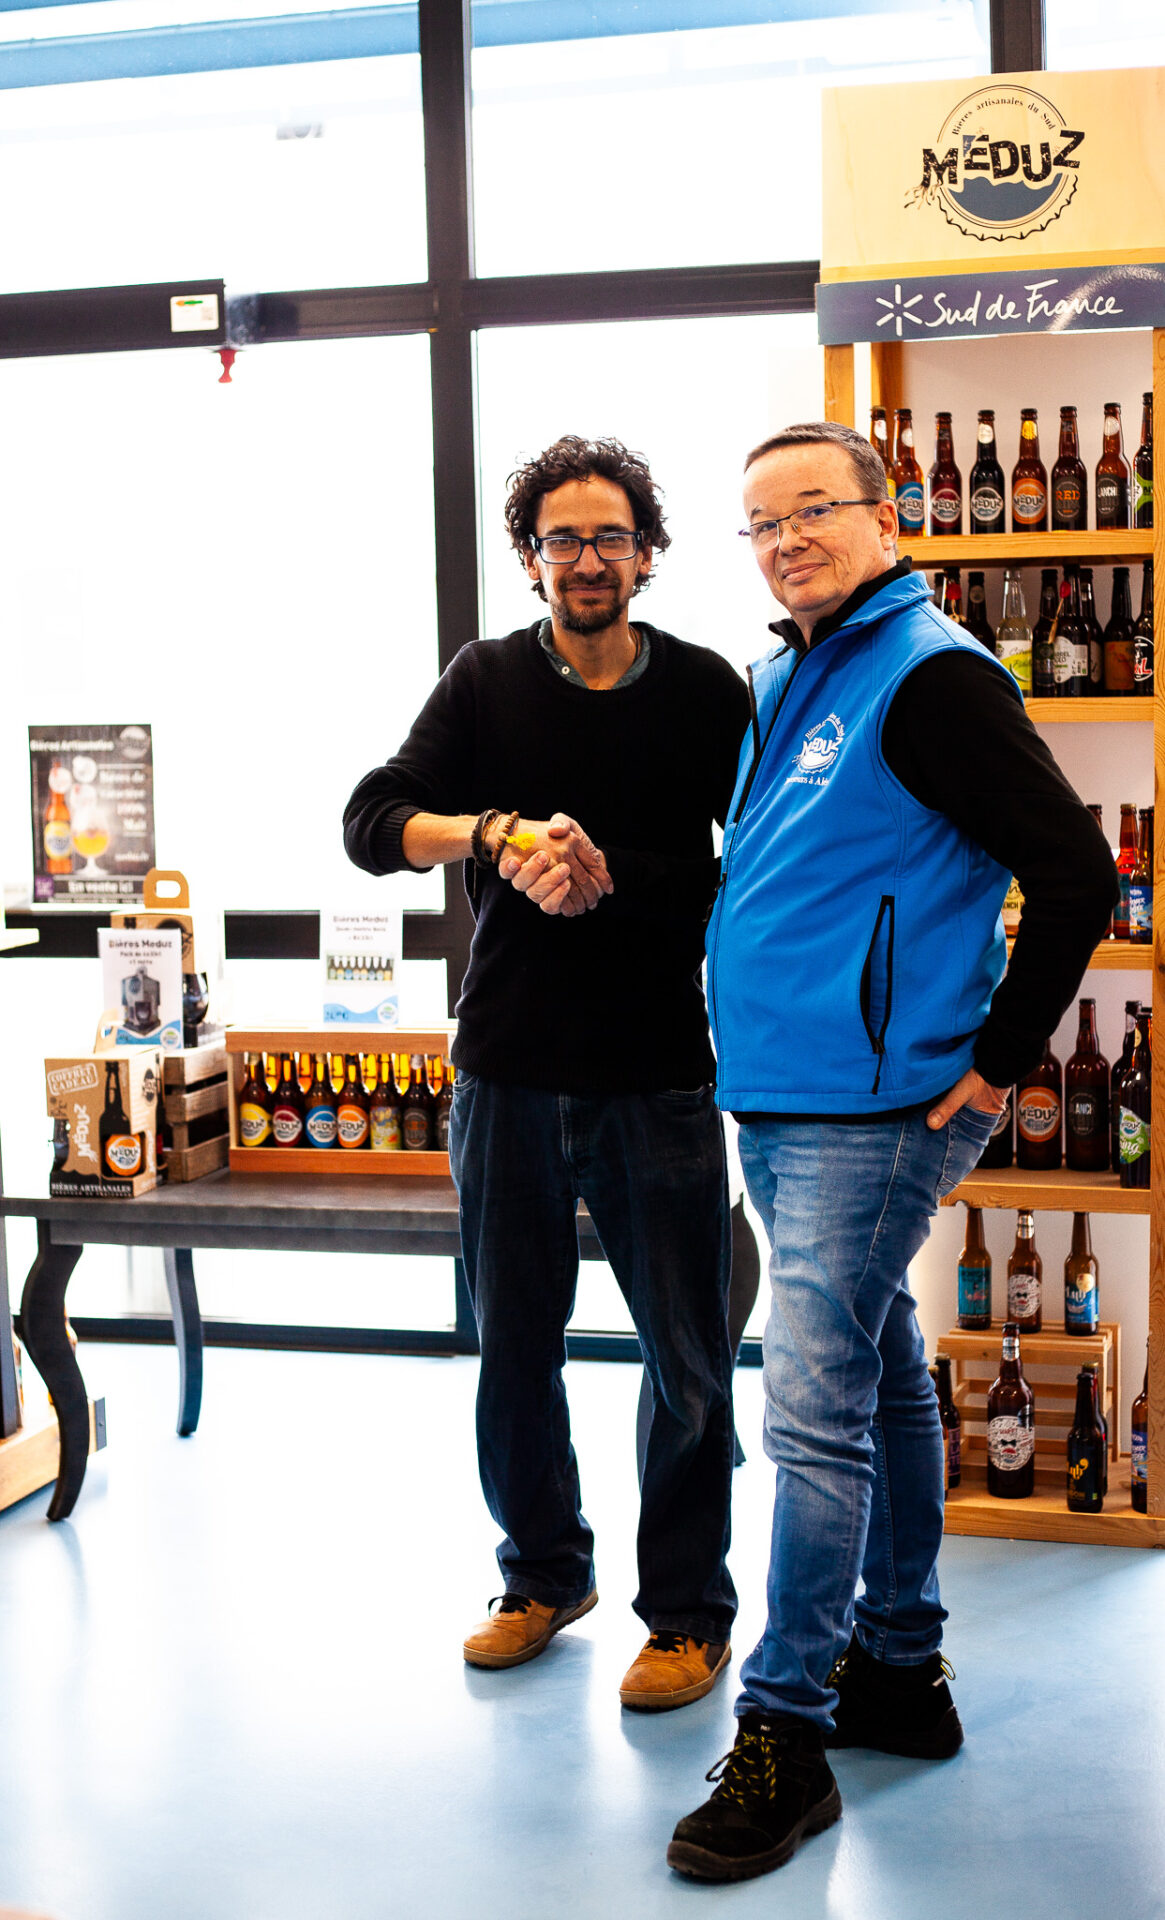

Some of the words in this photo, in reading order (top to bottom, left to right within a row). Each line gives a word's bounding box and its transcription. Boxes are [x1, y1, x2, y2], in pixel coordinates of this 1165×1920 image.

[976, 97, 1024, 111] artisanales
[1027, 103, 1040, 113] du
[1040, 112, 1056, 130] Sud
[921, 129, 1085, 188] MÉDUZ
[925, 290, 981, 328] Sud
[985, 293, 1022, 322] de
[1024, 278, 1124, 323] France
[1056, 490, 1080, 500] RED
